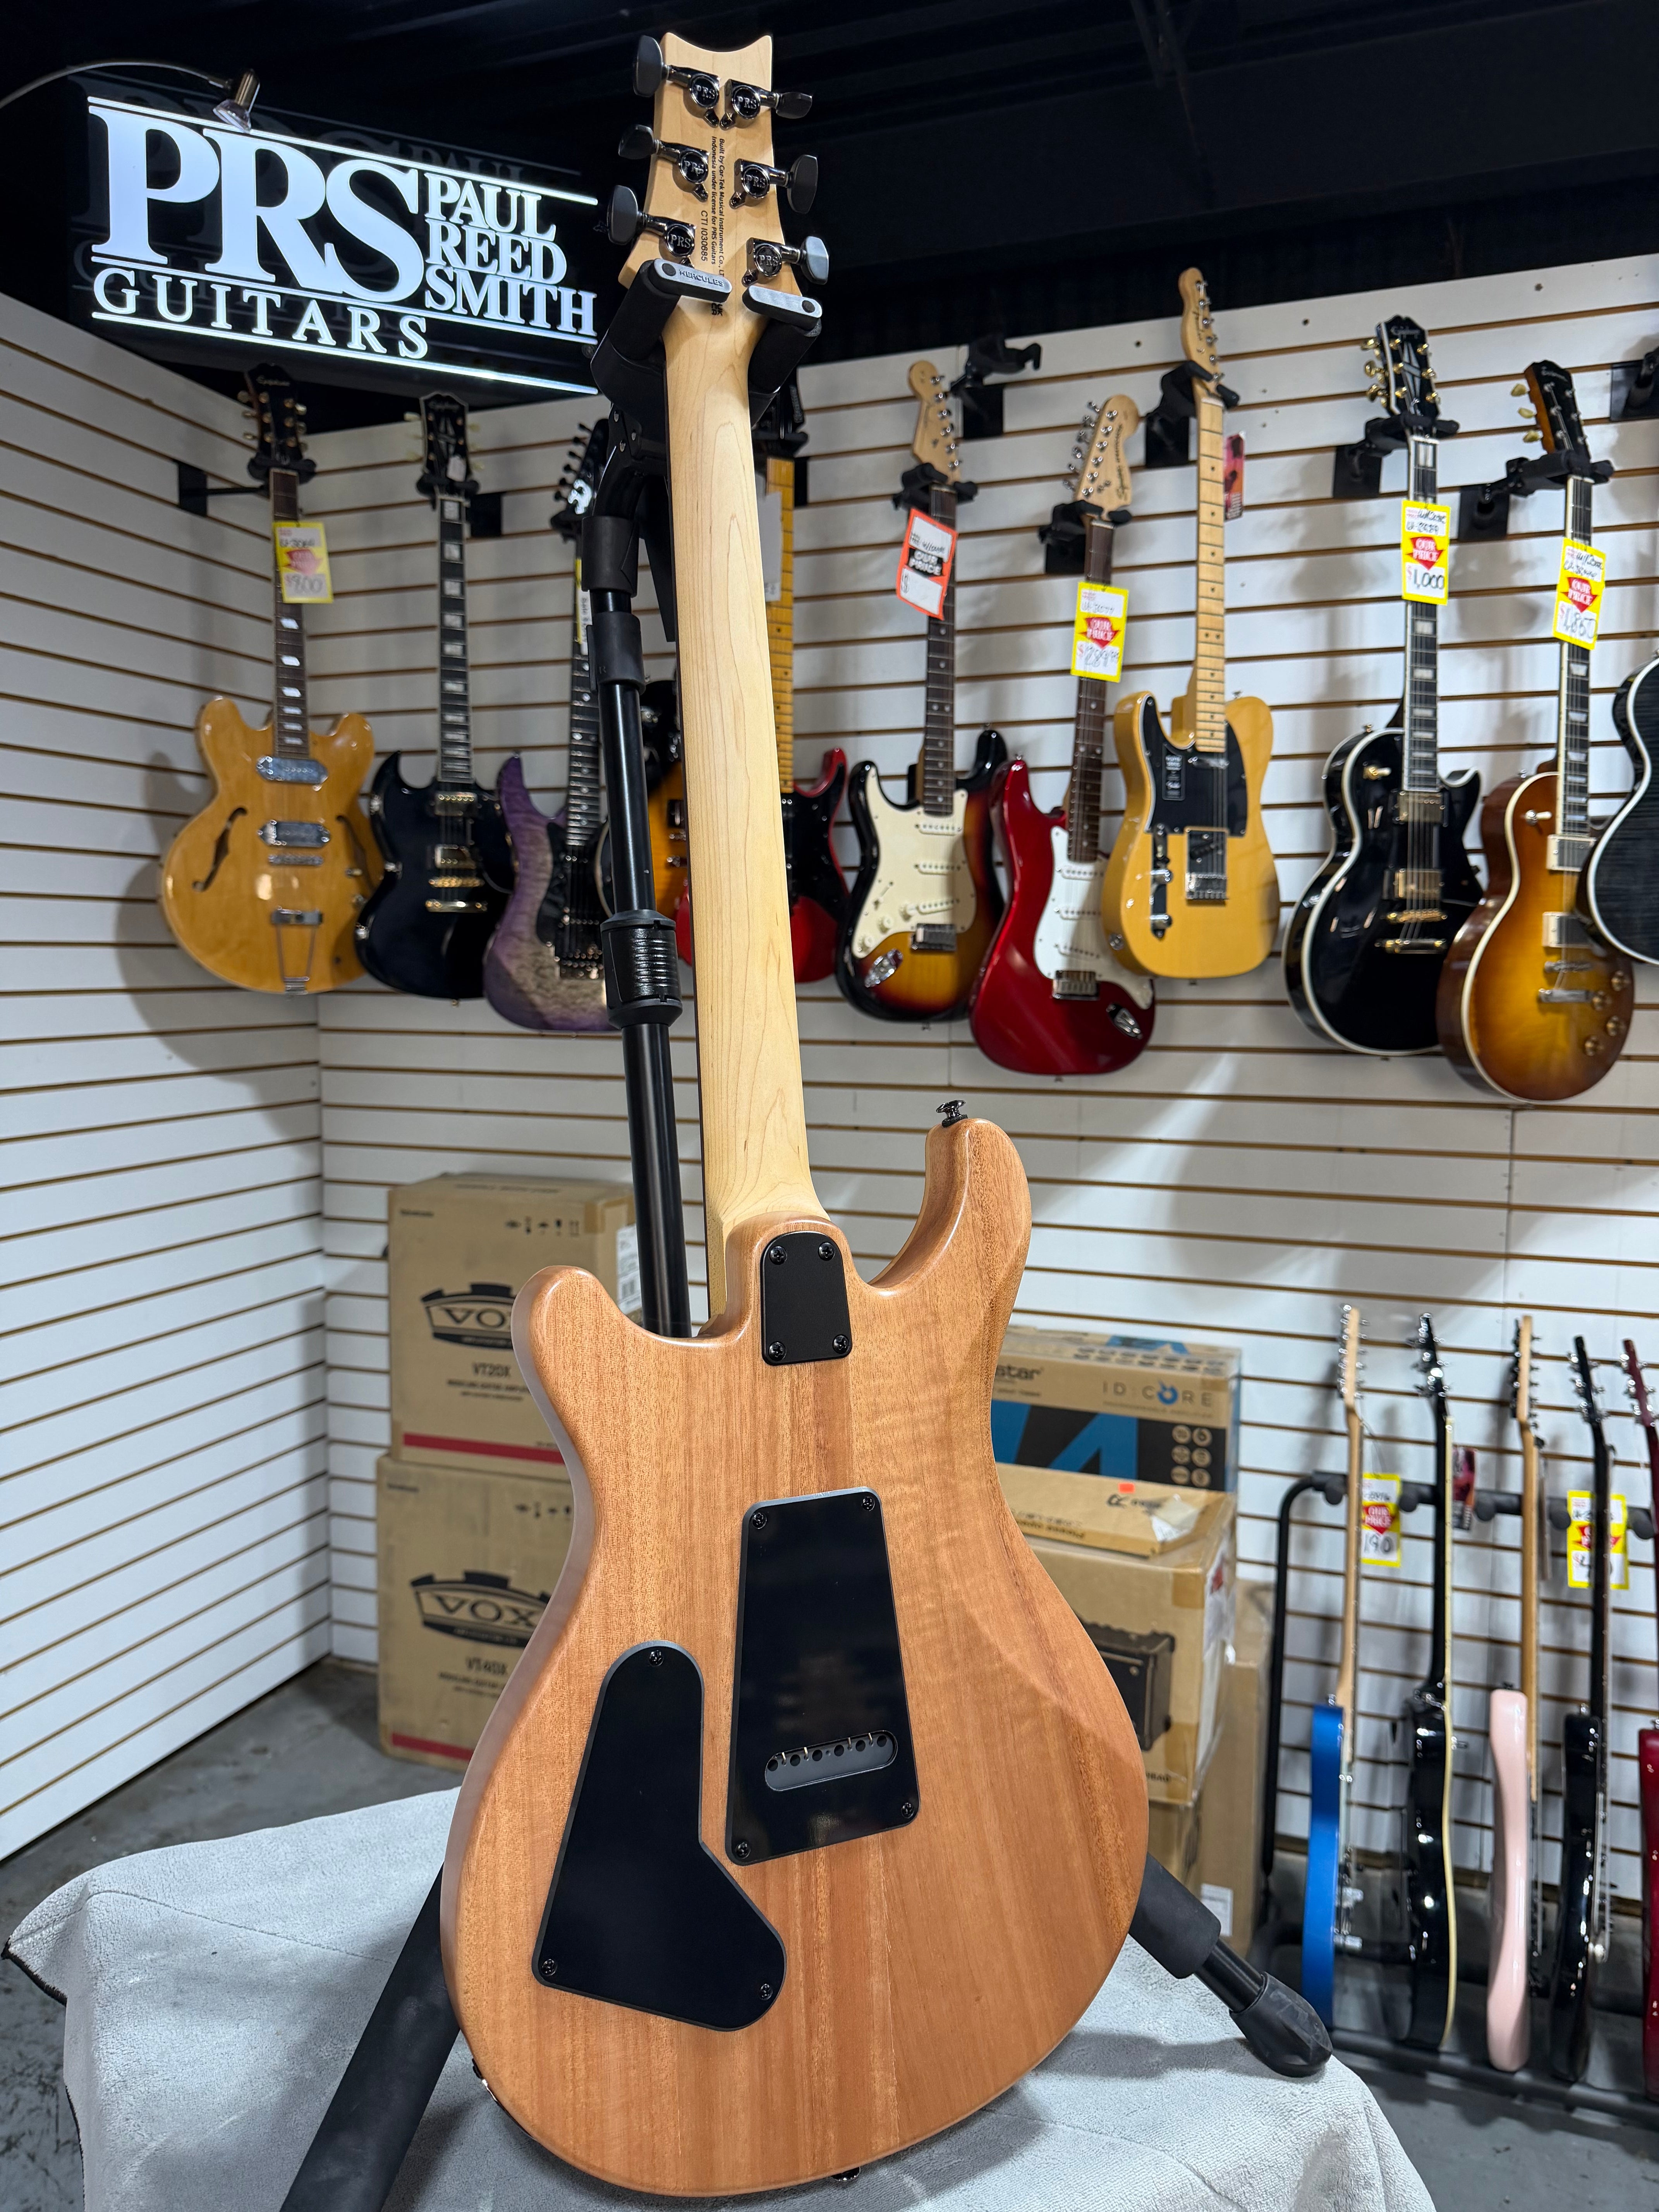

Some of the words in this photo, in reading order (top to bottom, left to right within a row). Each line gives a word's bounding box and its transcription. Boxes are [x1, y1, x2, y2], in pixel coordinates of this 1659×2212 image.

[696, 84, 716, 100] PRS
[737, 96, 757, 110] PRS
[684, 160, 704, 174] PRS
[718, 156, 725, 164] by
[746, 174, 766, 188] PRS
[89, 106, 424, 303] PRS
[424, 172, 557, 242] PAUL
[670, 234, 692, 249] PRS
[424, 218, 568, 286] REED
[759, 255, 778, 266] PRS
[679, 270, 724, 287] HERCULES
[424, 265, 598, 337] SMITH
[94, 268, 428, 359] GUITARS
[1415, 538, 1437, 551] OUR
[914, 549, 938, 565] OUR
[1413, 548, 1440, 562] PRICE
[908, 557, 943, 576] PRICE
[1571, 578, 1592, 594] OUR
[1568, 589, 1594, 606] PRICE
[440, 1305, 512, 1329] VO
[996, 1364, 1042, 1381] star
[1368, 1506, 1390, 1516] OUR
[1365, 1515, 1392, 1528] PRICE
[431, 1592, 541, 1627] VOX
